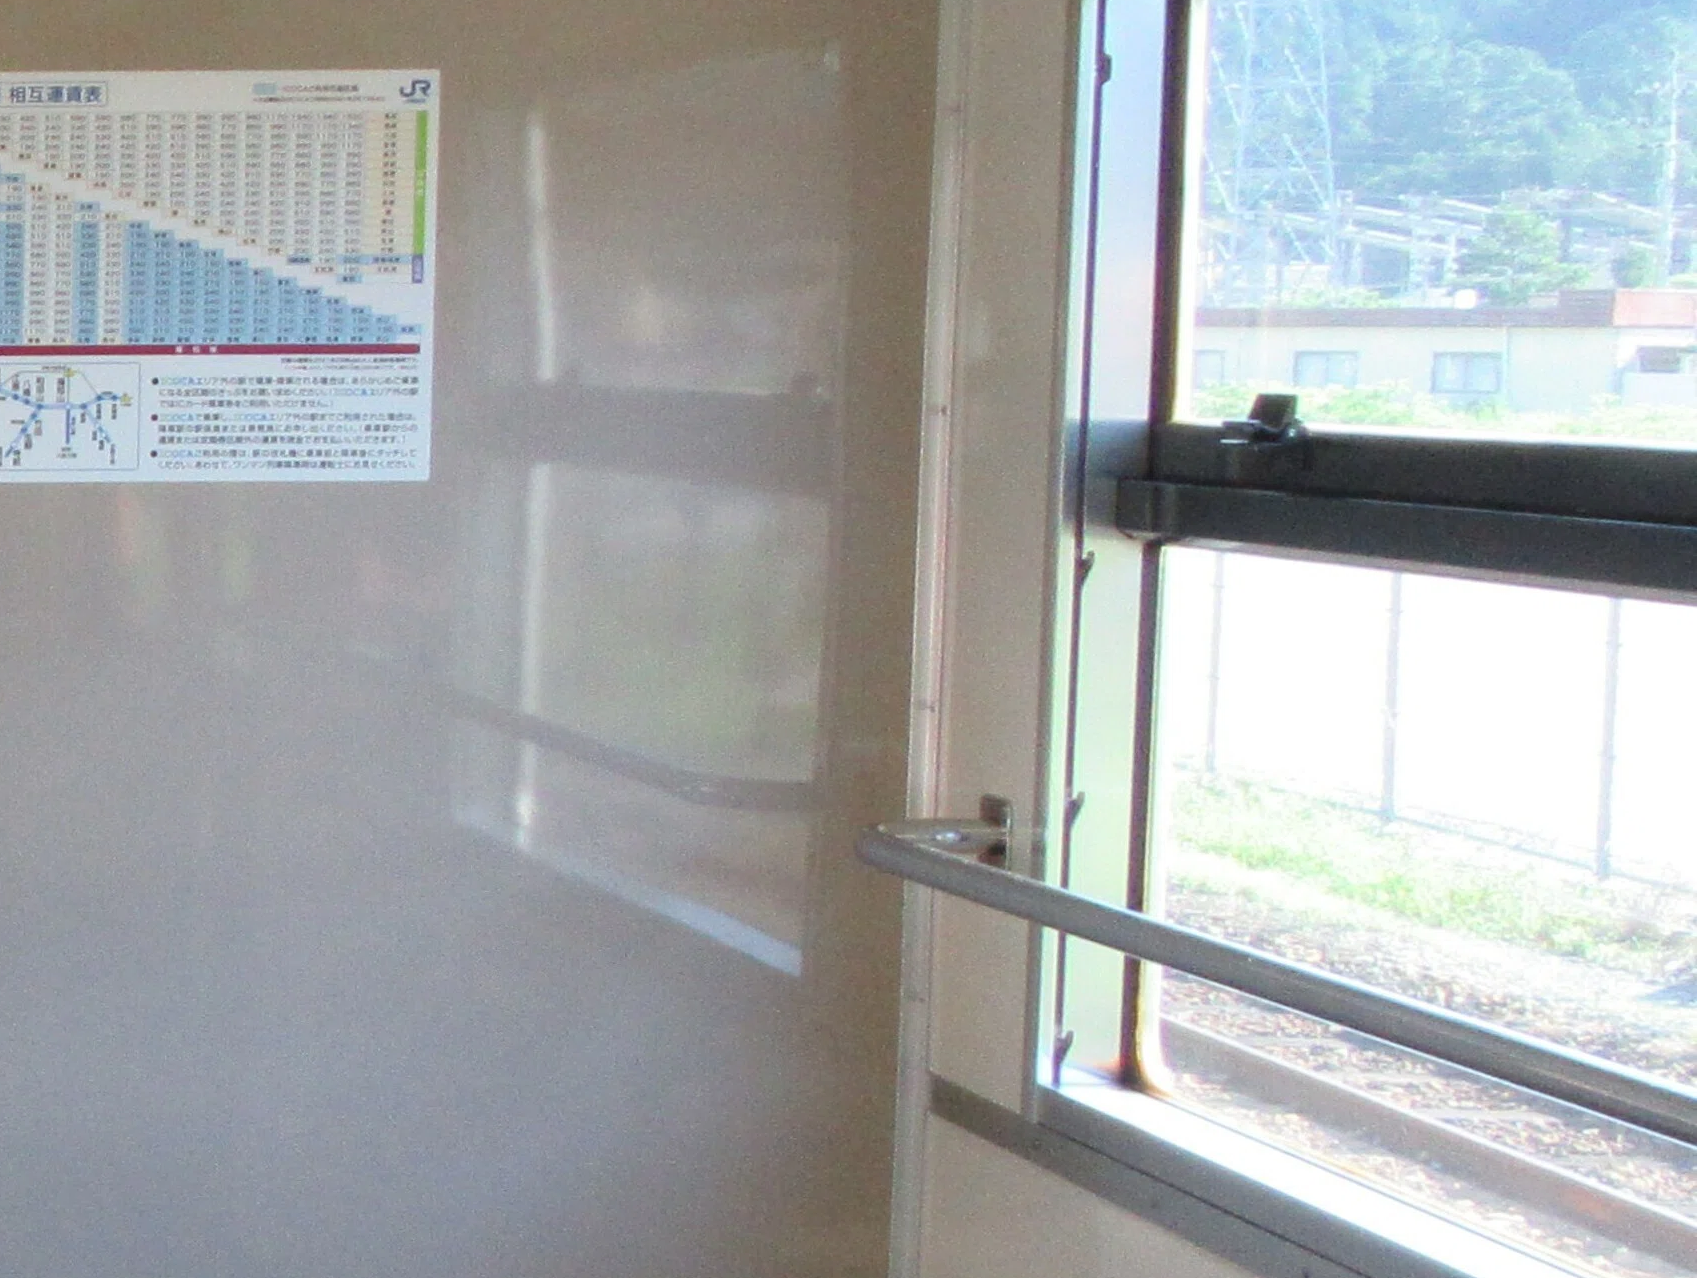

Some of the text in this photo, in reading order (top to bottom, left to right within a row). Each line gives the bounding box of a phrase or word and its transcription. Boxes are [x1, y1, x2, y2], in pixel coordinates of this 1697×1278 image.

[10, 85, 102, 104] 相互運賃表
[400, 79, 432, 98] JR
